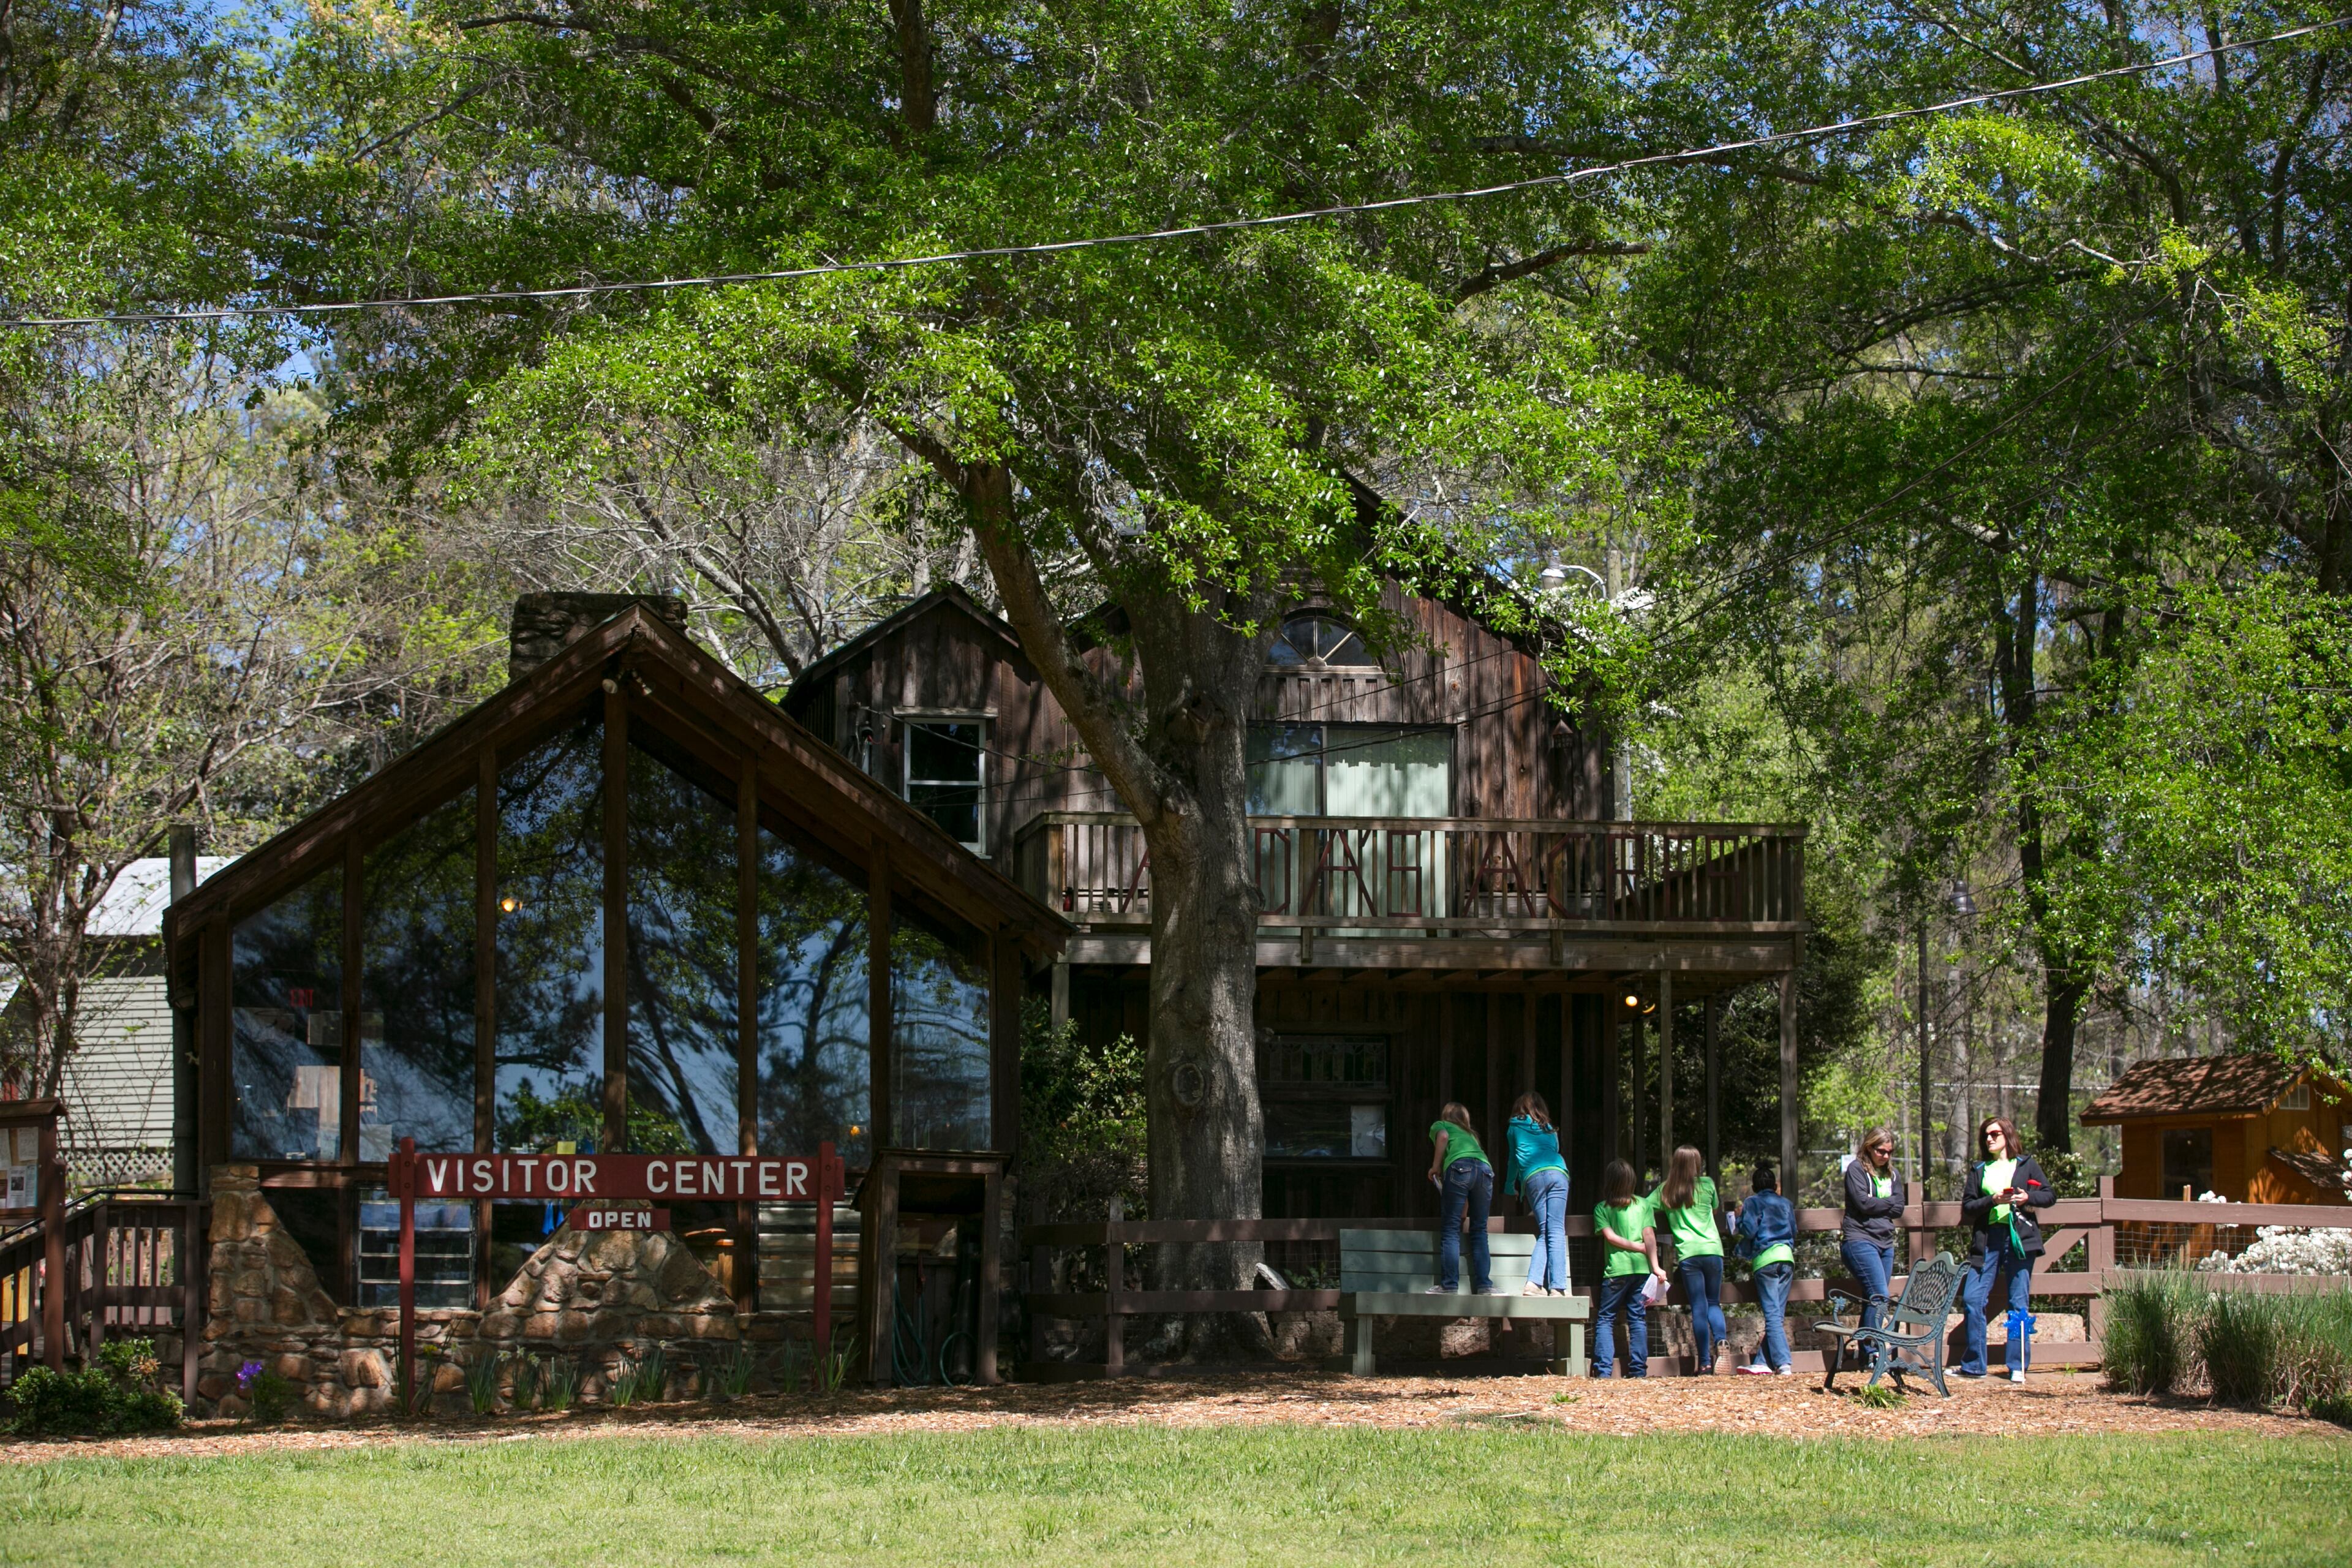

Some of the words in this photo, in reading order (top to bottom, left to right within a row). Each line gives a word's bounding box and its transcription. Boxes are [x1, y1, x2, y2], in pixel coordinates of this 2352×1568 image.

[1462, 832, 1740, 921] ACRES
[428, 1159, 596, 1192] VISITOR
[647, 1161, 807, 1194] CENTER
[589, 1212, 650, 1227] OPEN
